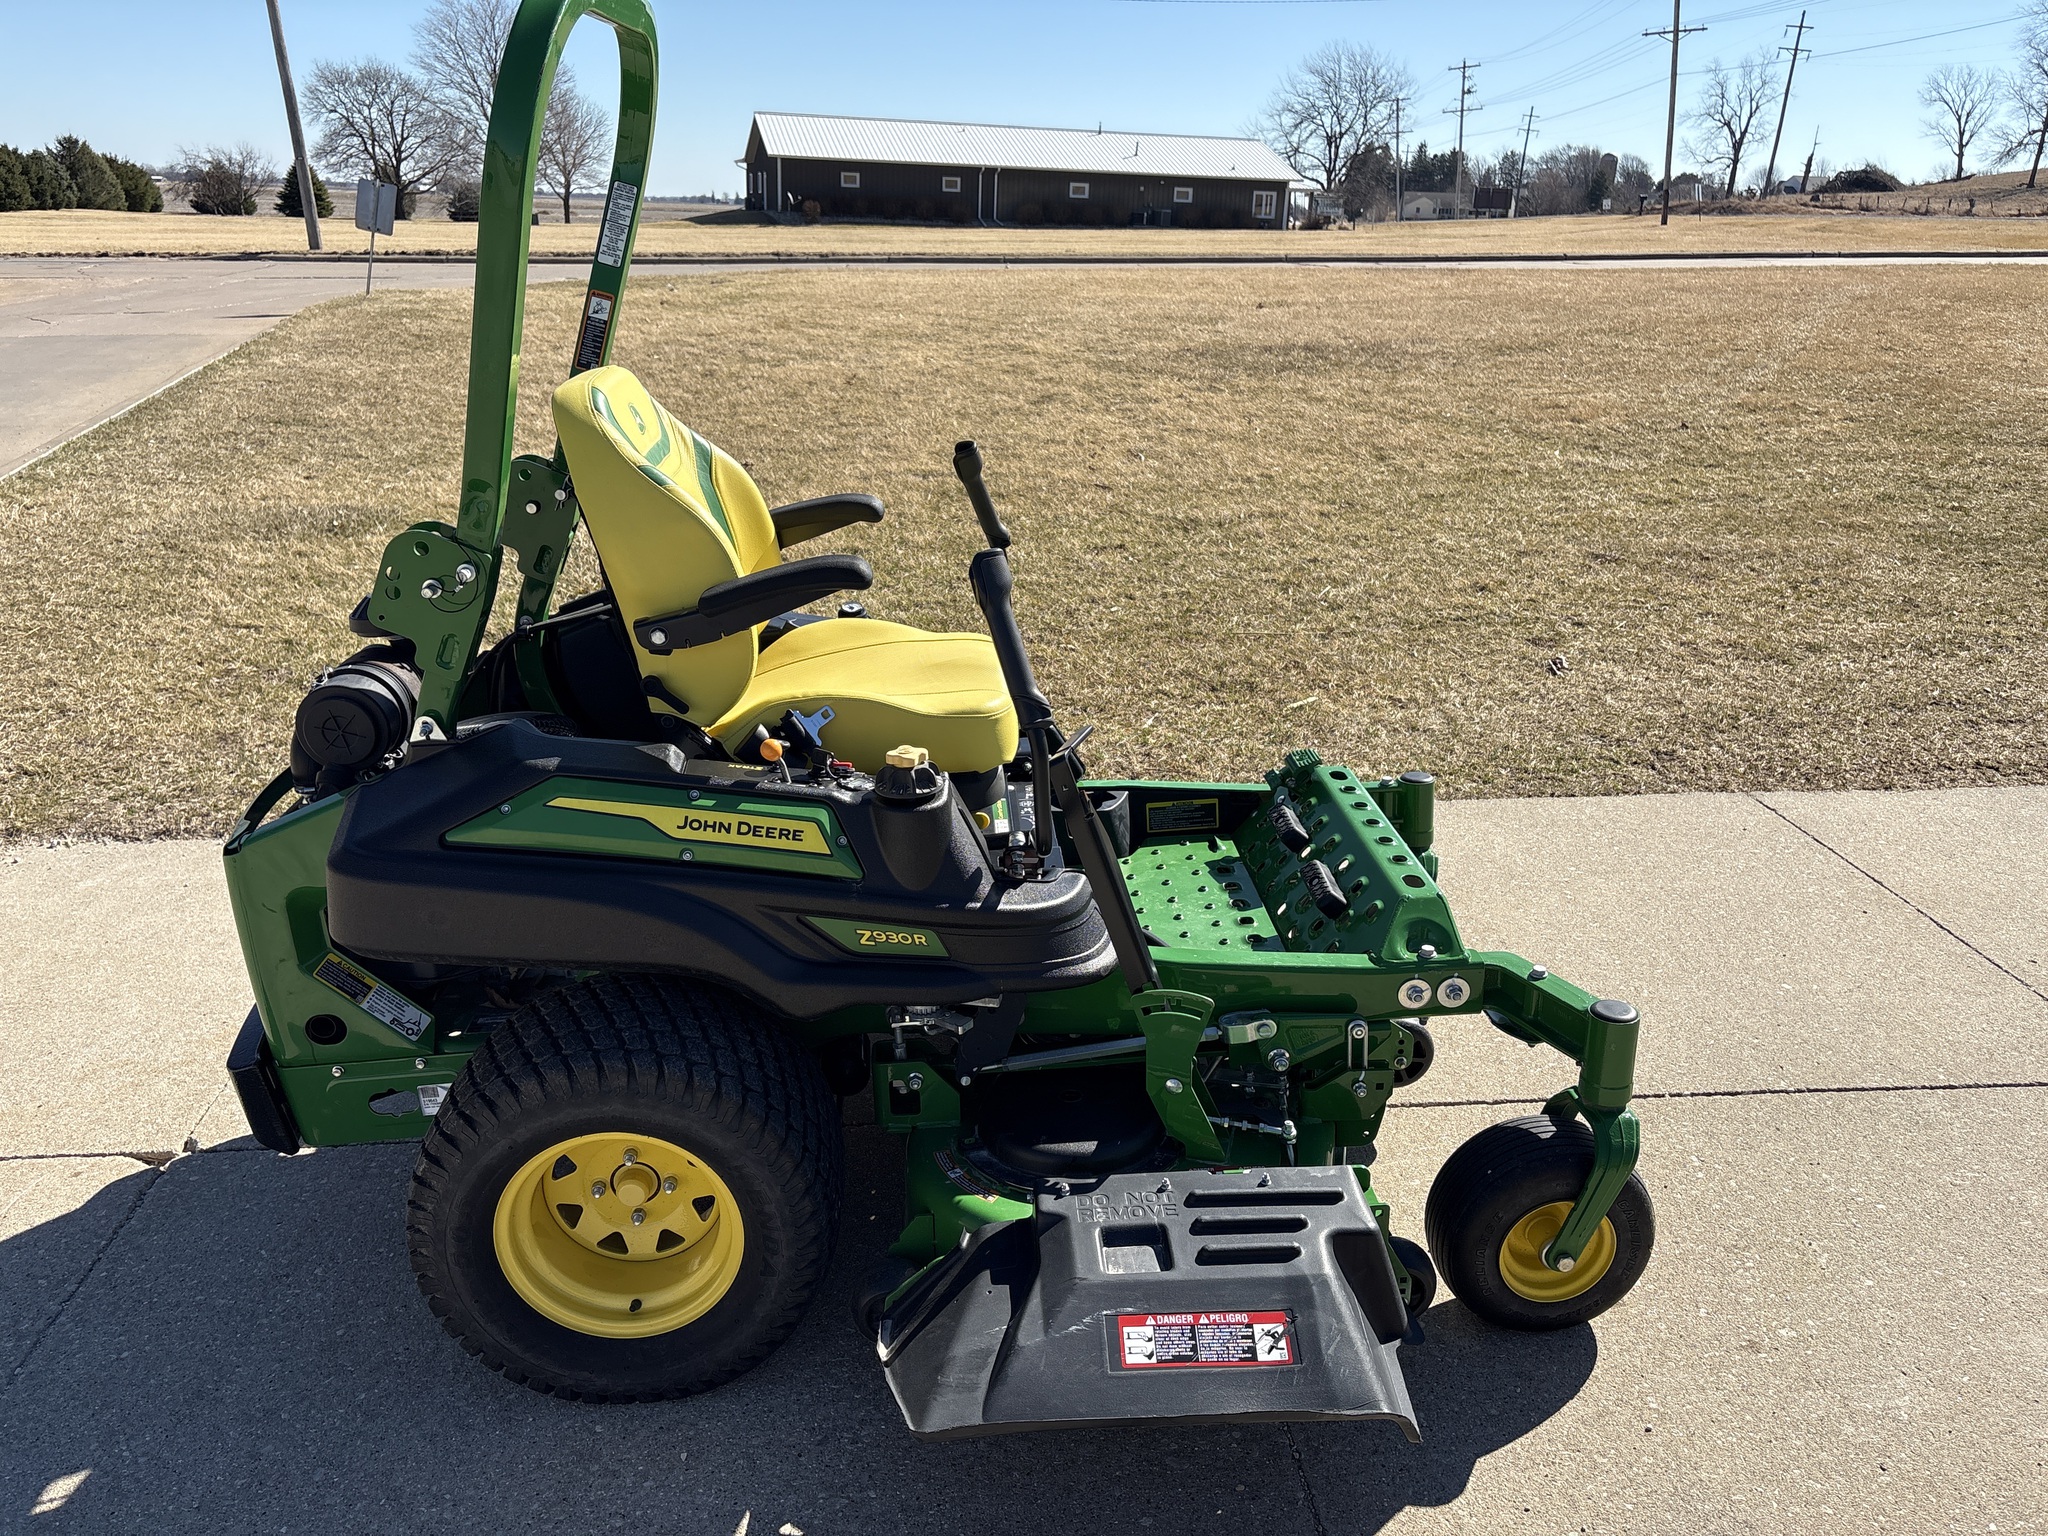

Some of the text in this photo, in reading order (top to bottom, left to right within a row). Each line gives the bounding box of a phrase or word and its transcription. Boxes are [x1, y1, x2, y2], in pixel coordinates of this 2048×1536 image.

[677, 815, 805, 842] JOHN DEERE
[855, 929, 929, 946] Z930R
[342, 963, 367, 981] CAUTION
[1075, 1191, 1175, 1208] DO NOT
[1076, 1203, 1180, 1222] REMOVE
[1616, 1199, 1642, 1280] CARLISLE
[1474, 1210, 1504, 1297] RELIANCE
[1156, 1313, 1248, 1324] DANGER PELIGRO
